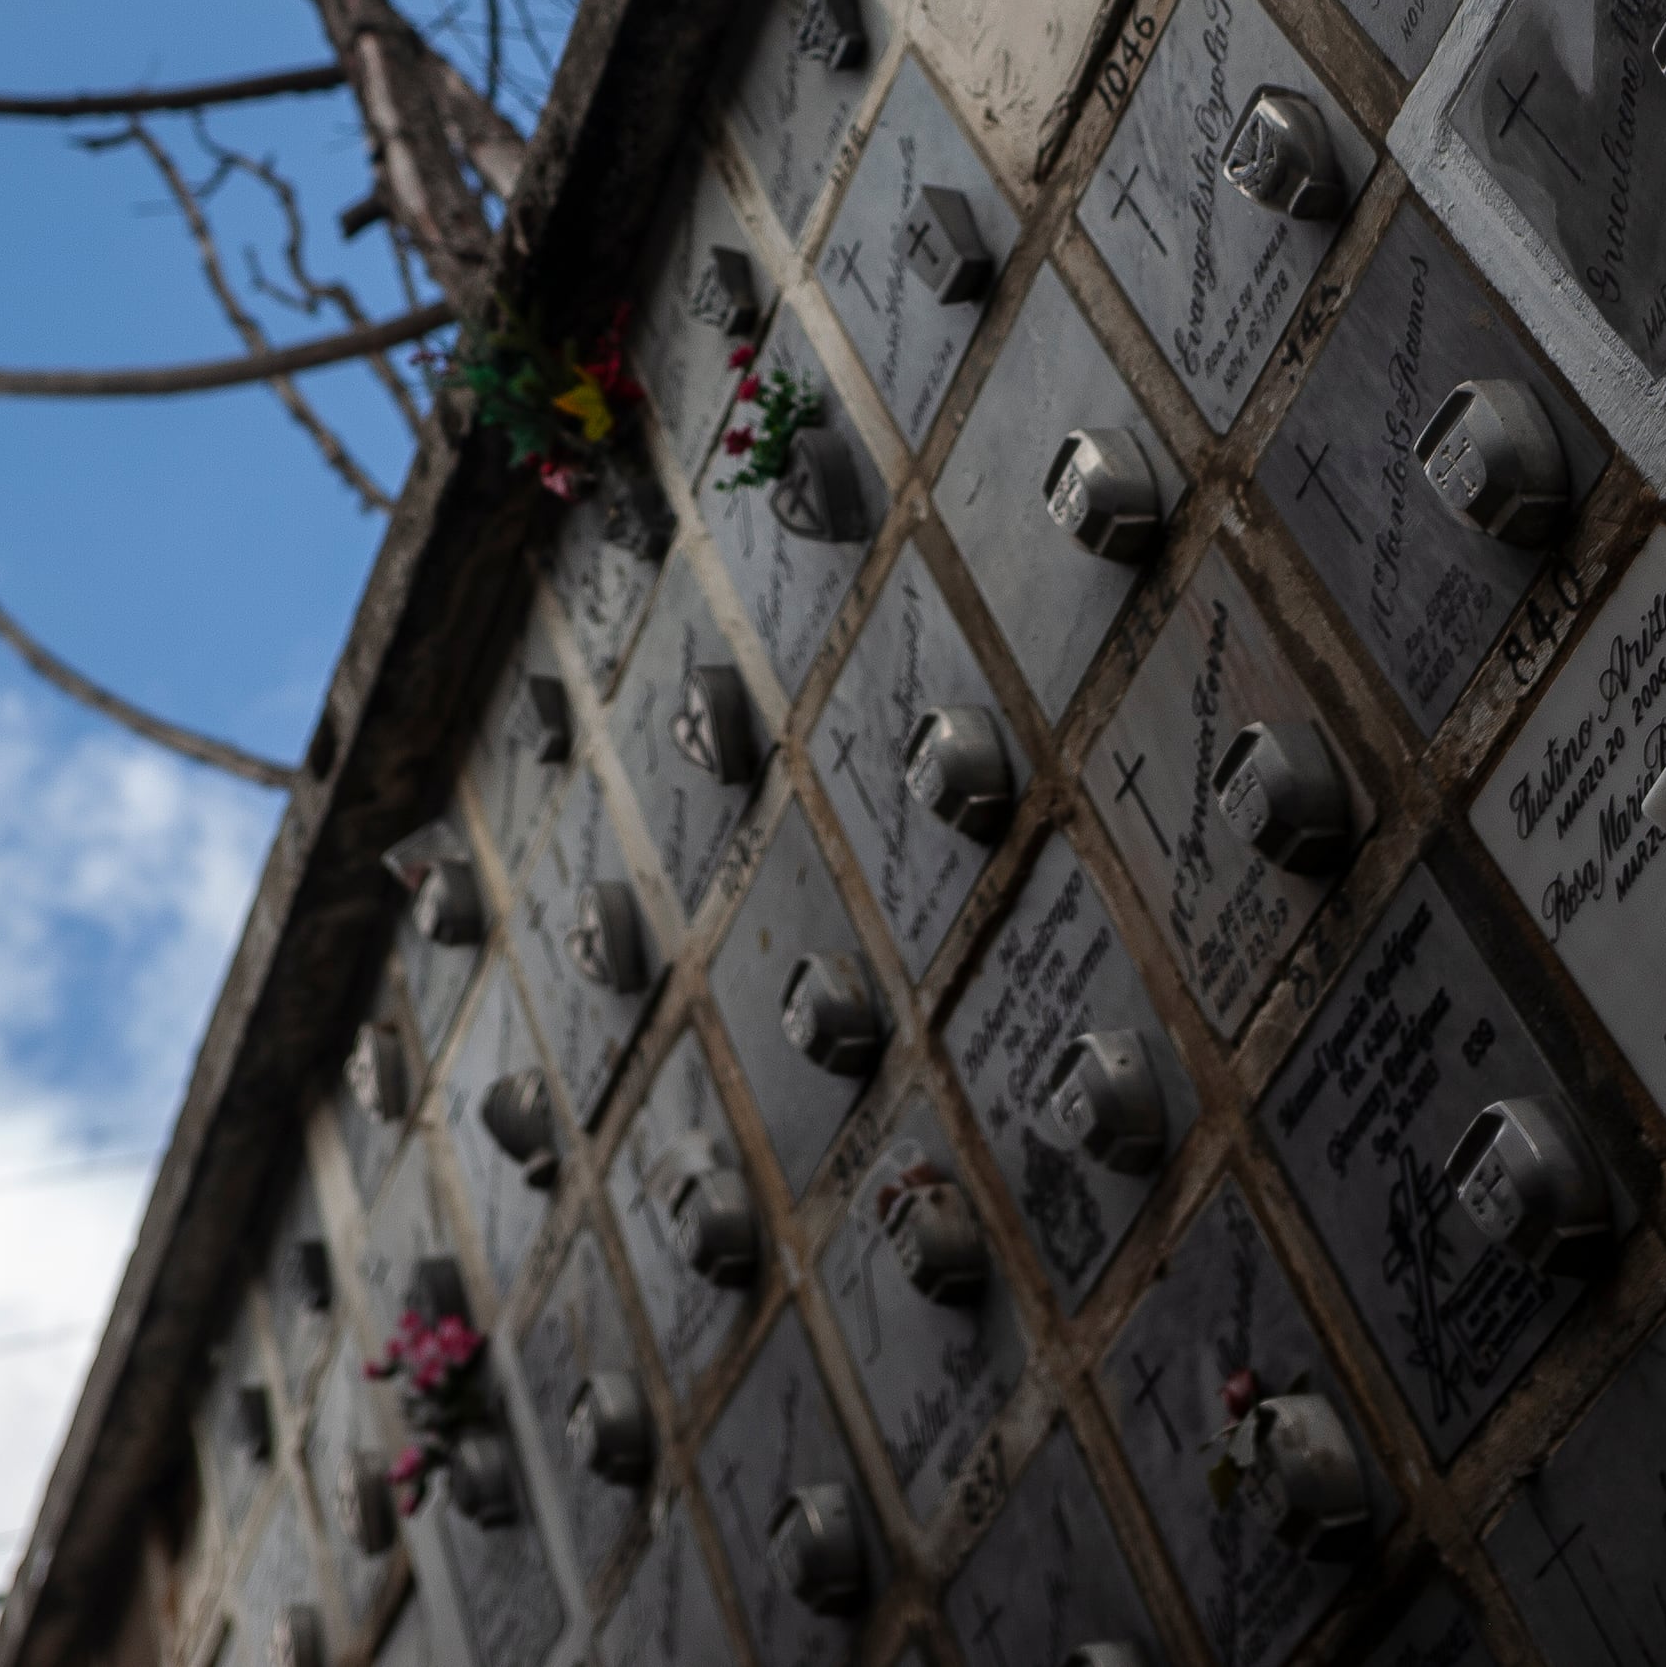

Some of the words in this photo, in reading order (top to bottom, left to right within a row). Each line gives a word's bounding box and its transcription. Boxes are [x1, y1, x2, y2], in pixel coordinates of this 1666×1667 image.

[1097, 11, 1158, 119] 1046
[1508, 569, 1593, 684] 840
[1557, 756, 1605, 839] MARZO
[1604, 725, 1626, 765] 20
[1549, 860, 1599, 945] Rosa
